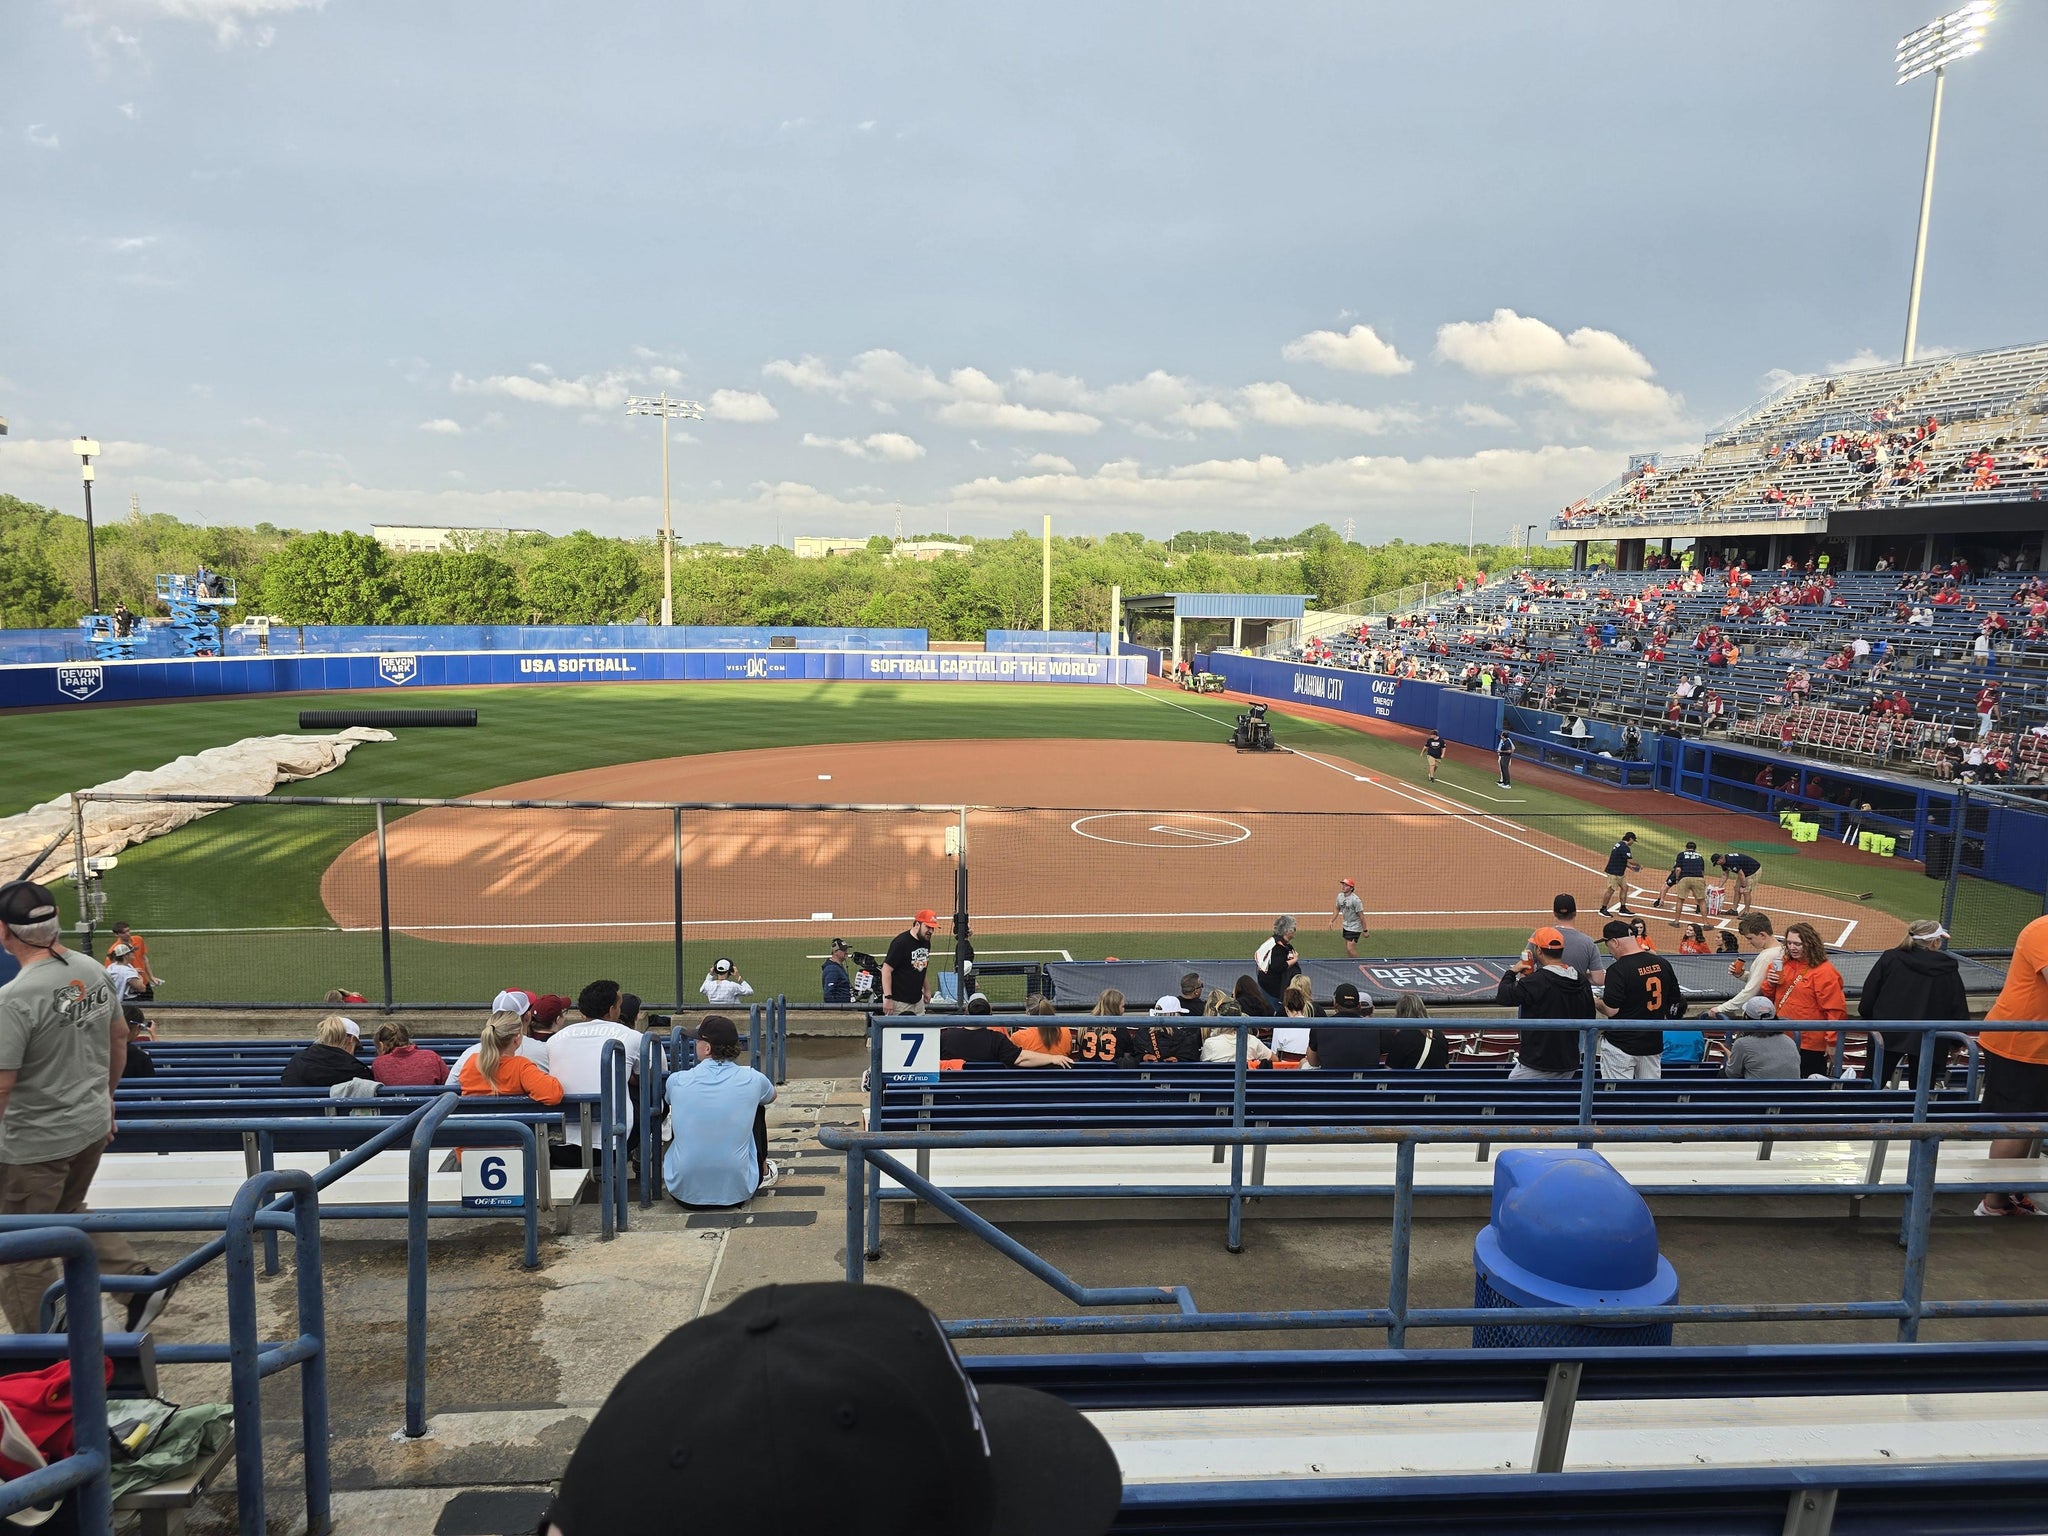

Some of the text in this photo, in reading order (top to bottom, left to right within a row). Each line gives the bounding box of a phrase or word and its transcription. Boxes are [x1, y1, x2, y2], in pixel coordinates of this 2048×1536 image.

[382, 657, 414, 666] DEVON
[520, 657, 631, 673] USA SOFTBALL
[870, 659, 1097, 676] SOFTBALL CAPITAL OF THE WORLD
[61, 669, 99, 678] DEVON
[386, 665, 411, 673] PARK
[65, 677, 96, 686] PARK
[1293, 672, 1344, 701] OKLAHOMA CITY
[1373, 696, 1394, 707] ENERGY
[1375, 706, 1390, 716] FIELD
[1370, 965, 1481, 979] DEVON
[1391, 975, 1481, 987] PARK
[1645, 976, 1663, 1012] 3
[901, 1033, 924, 1067] 7
[1083, 1031, 1117, 1061] 33
[480, 1156, 507, 1191] 6
